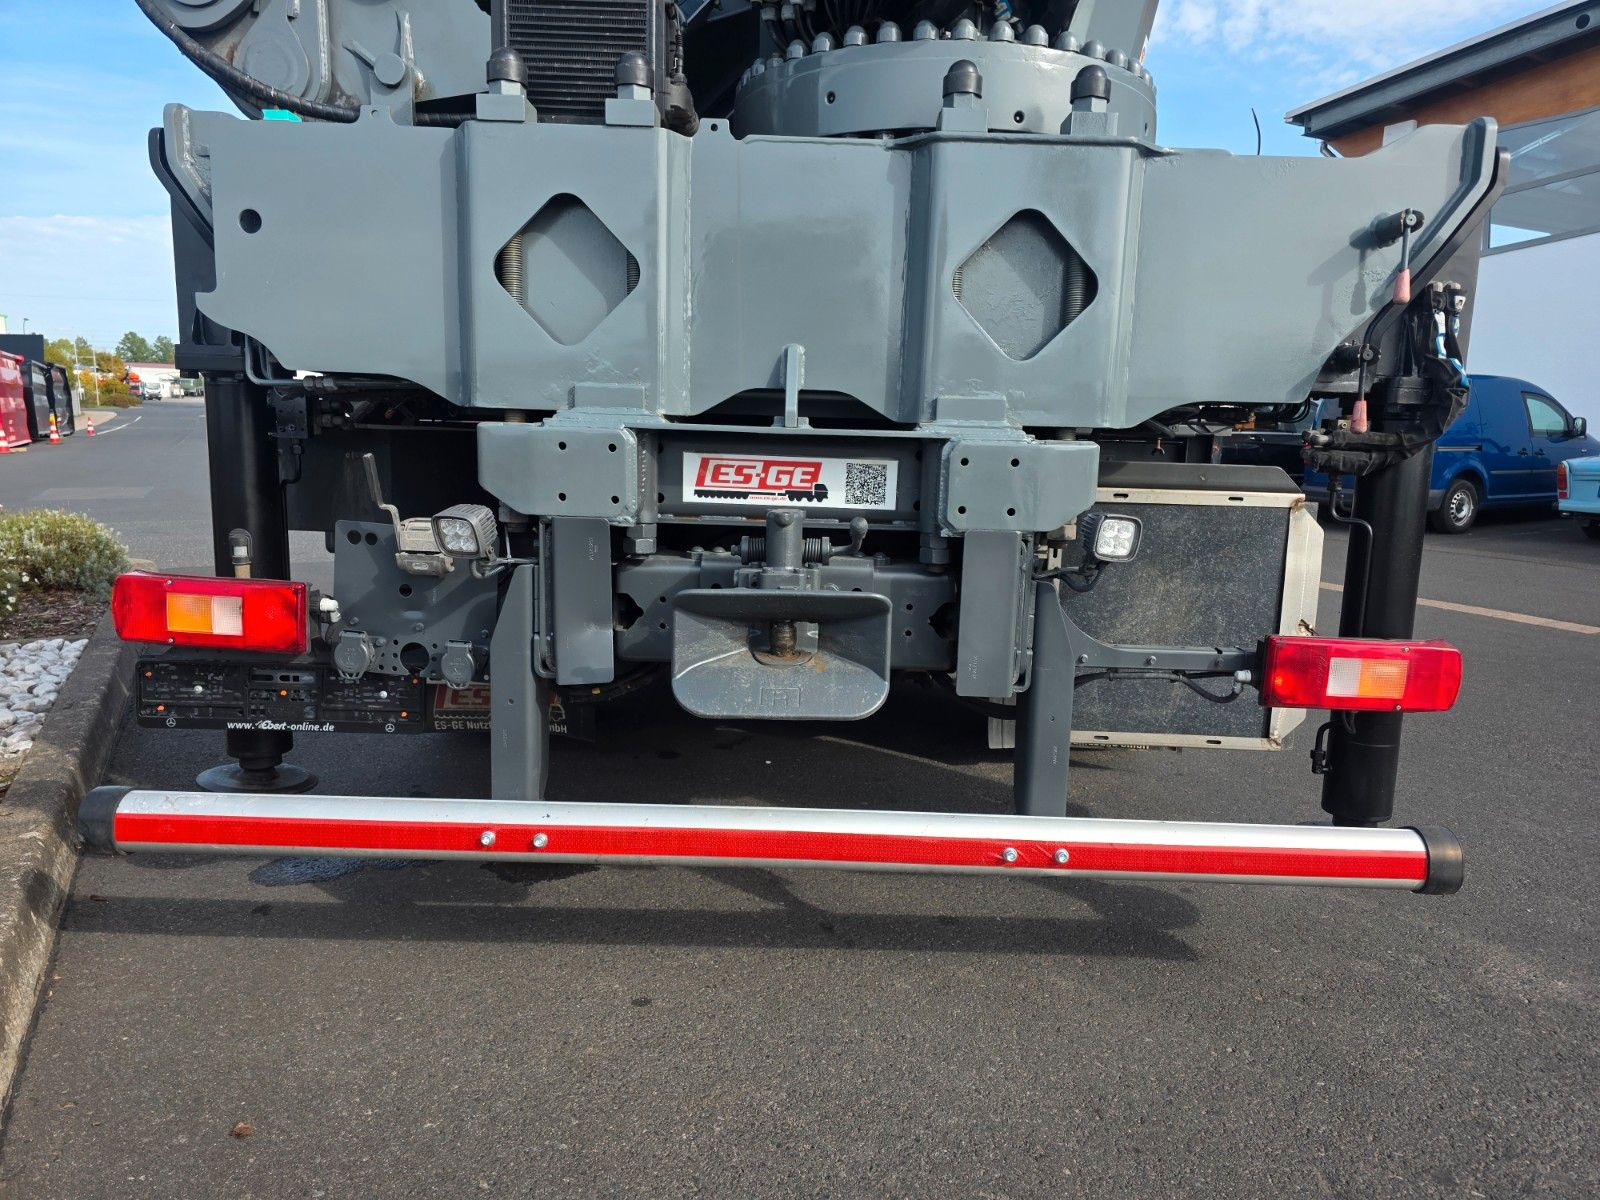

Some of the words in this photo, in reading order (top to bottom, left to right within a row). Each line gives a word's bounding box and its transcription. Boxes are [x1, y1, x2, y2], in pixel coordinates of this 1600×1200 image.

[450, 688, 491, 705] ES
[434, 720, 465, 730] ES-GE
[467, 720, 491, 730] Nutz
